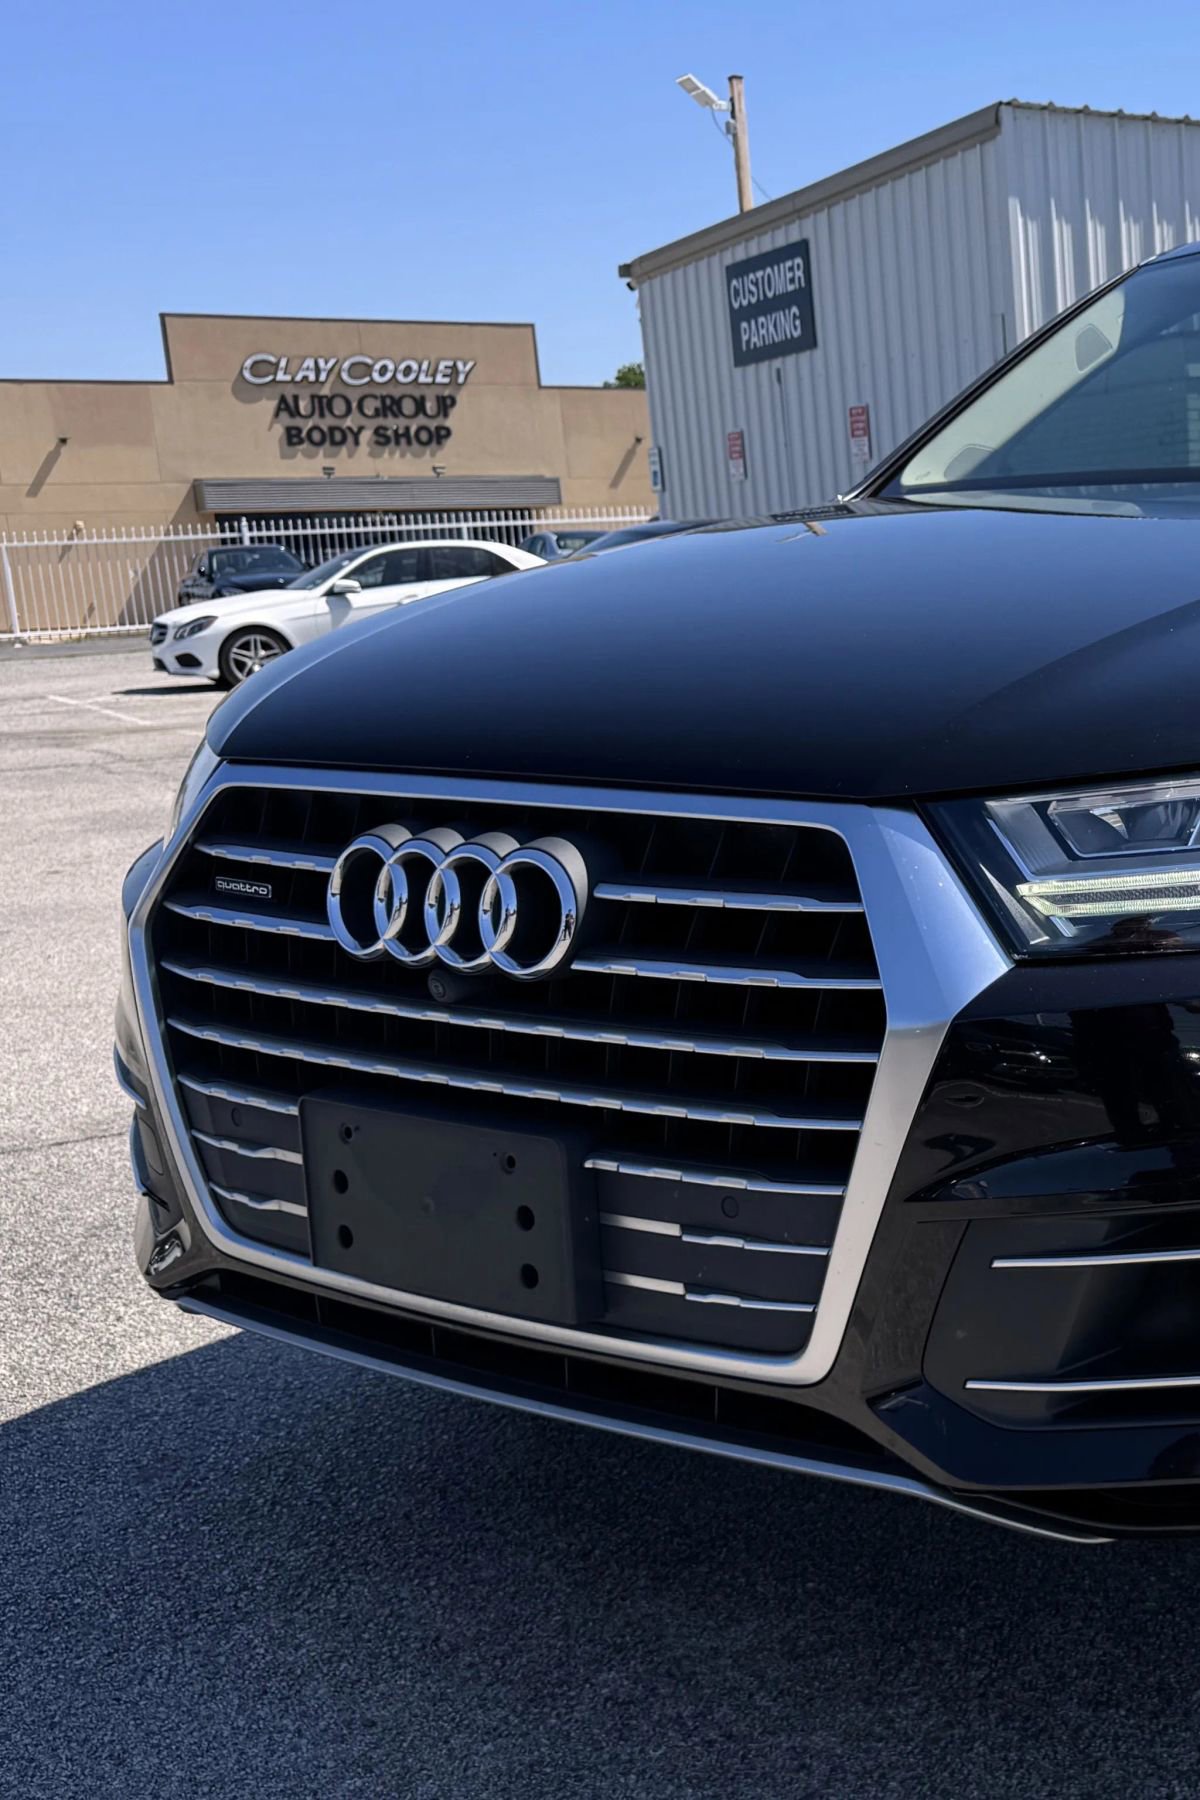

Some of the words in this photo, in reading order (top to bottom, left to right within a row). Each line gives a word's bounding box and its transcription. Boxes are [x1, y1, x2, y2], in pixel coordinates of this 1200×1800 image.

[730, 256, 806, 310] CUSTOMER
[740, 305, 802, 353] PARKING
[241, 352, 339, 385] CLAY
[339, 354, 477, 386] COOLEY
[274, 394, 352, 420] AUTO
[356, 394, 457, 420] GROUP
[284, 424, 365, 448] BODY
[373, 424, 453, 447] SHOP
[216, 880, 268, 895] quattro
